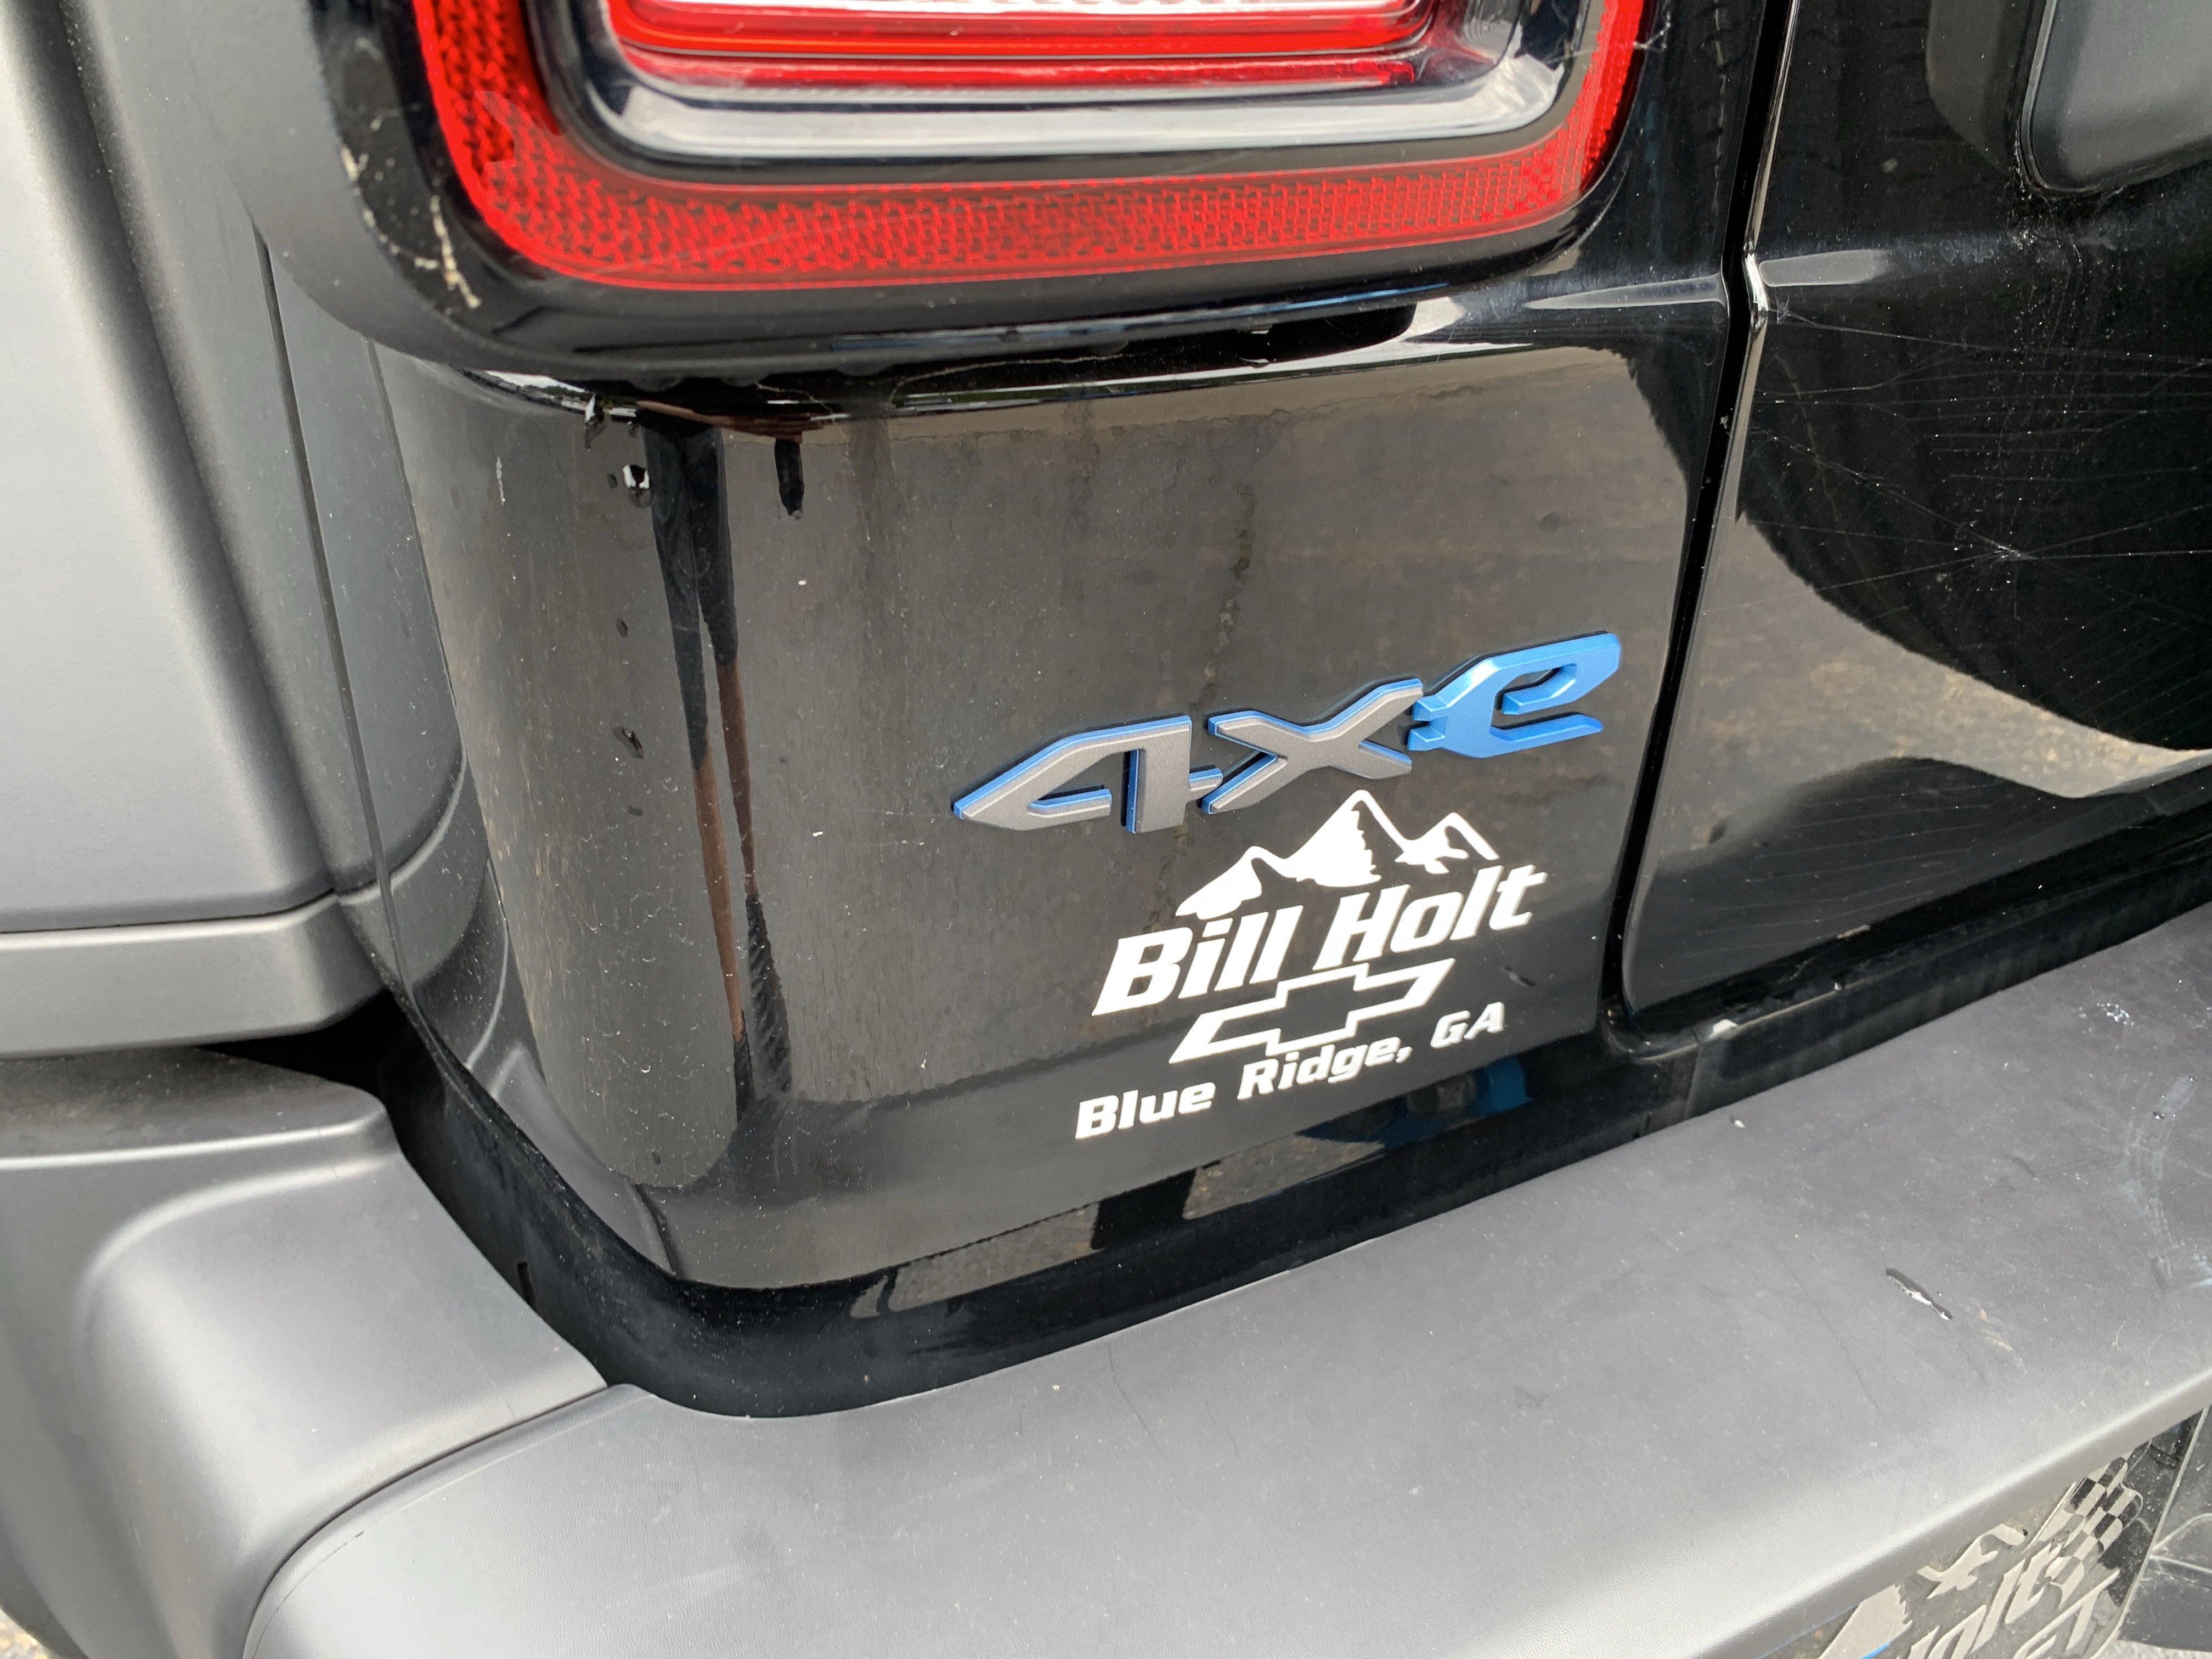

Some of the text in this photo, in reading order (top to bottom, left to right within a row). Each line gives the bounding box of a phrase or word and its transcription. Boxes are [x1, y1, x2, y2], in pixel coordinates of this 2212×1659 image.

[1092, 865, 1547, 1016] Bill Holt
[1075, 1002, 1504, 1139] Blue Ridge, GA
